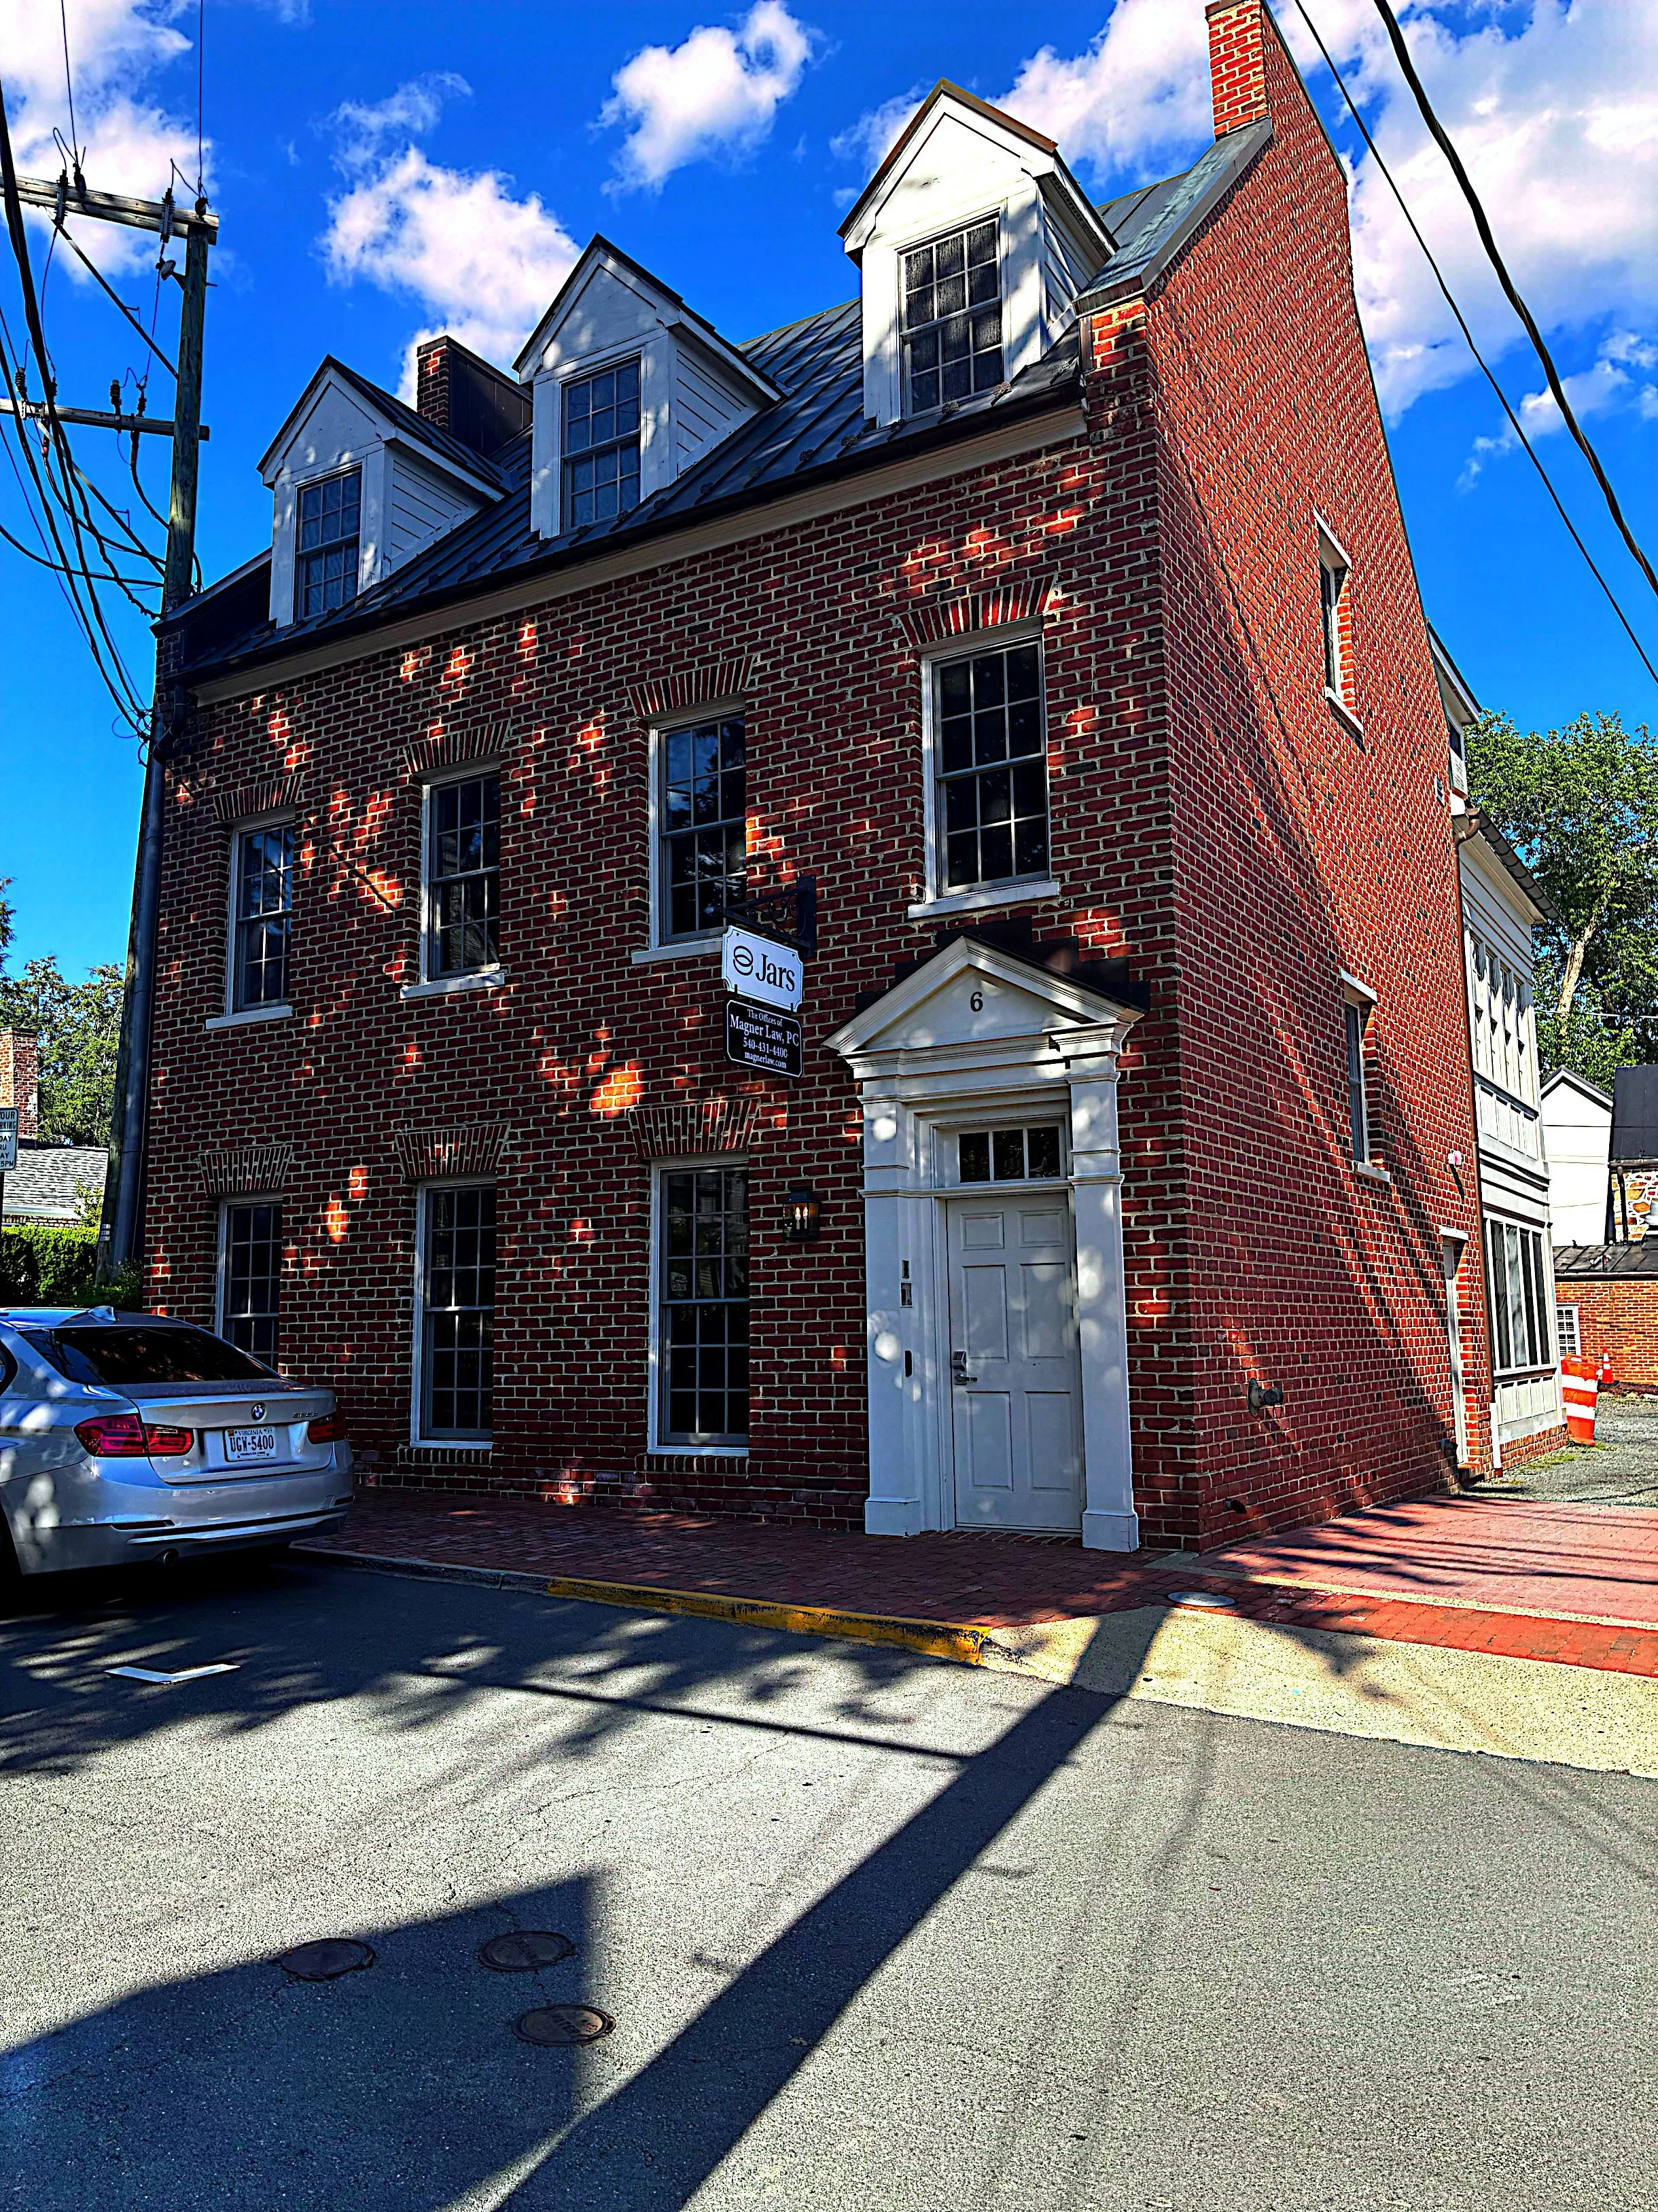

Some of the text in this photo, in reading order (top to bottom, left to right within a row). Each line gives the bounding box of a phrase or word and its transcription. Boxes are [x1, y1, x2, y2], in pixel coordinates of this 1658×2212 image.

[755, 953, 795, 992] Jars
[970, 991, 983, 1012] 6
[747, 1009, 758, 1019] The
[758, 1013, 776, 1025] Offices
[730, 1014, 799, 1046] Magner Law, PC
[743, 1037, 788, 1058] 540-431-4400
[744, 1052, 786, 1069] magnerlaw.com
[0, 1111, 15, 1120] OUR
[0, 1121, 16, 1129] RKING
